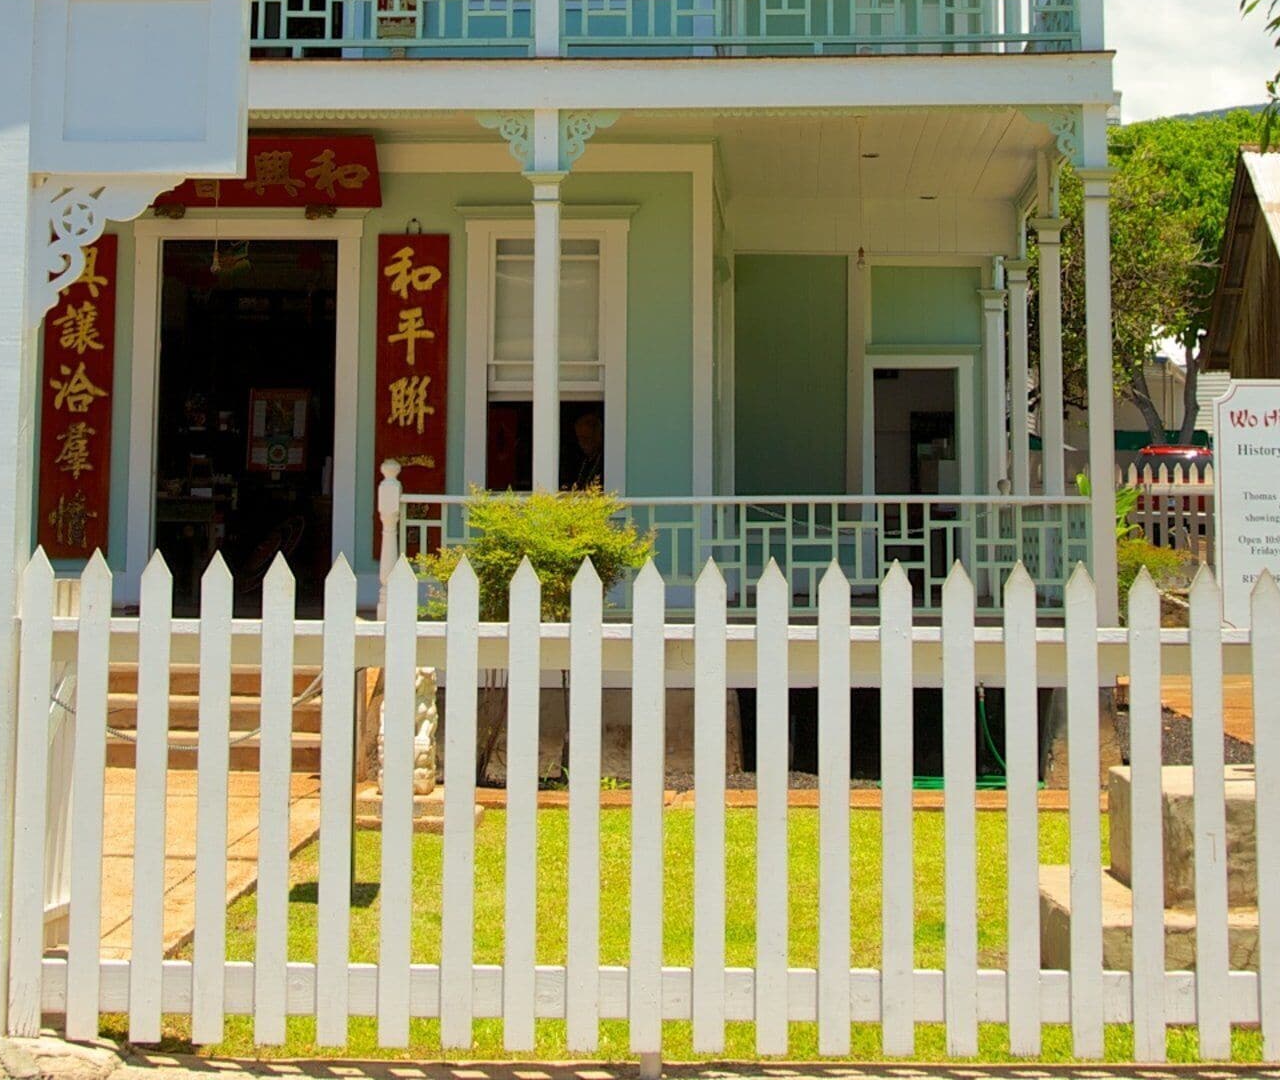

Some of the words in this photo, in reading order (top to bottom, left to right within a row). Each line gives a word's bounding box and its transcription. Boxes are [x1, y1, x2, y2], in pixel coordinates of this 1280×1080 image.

[1230, 409, 1258, 428] Wo
[1243, 491, 1277, 501] Thomas
[1245, 514, 1280, 524] showing
[1238, 536, 1262, 545] Open
